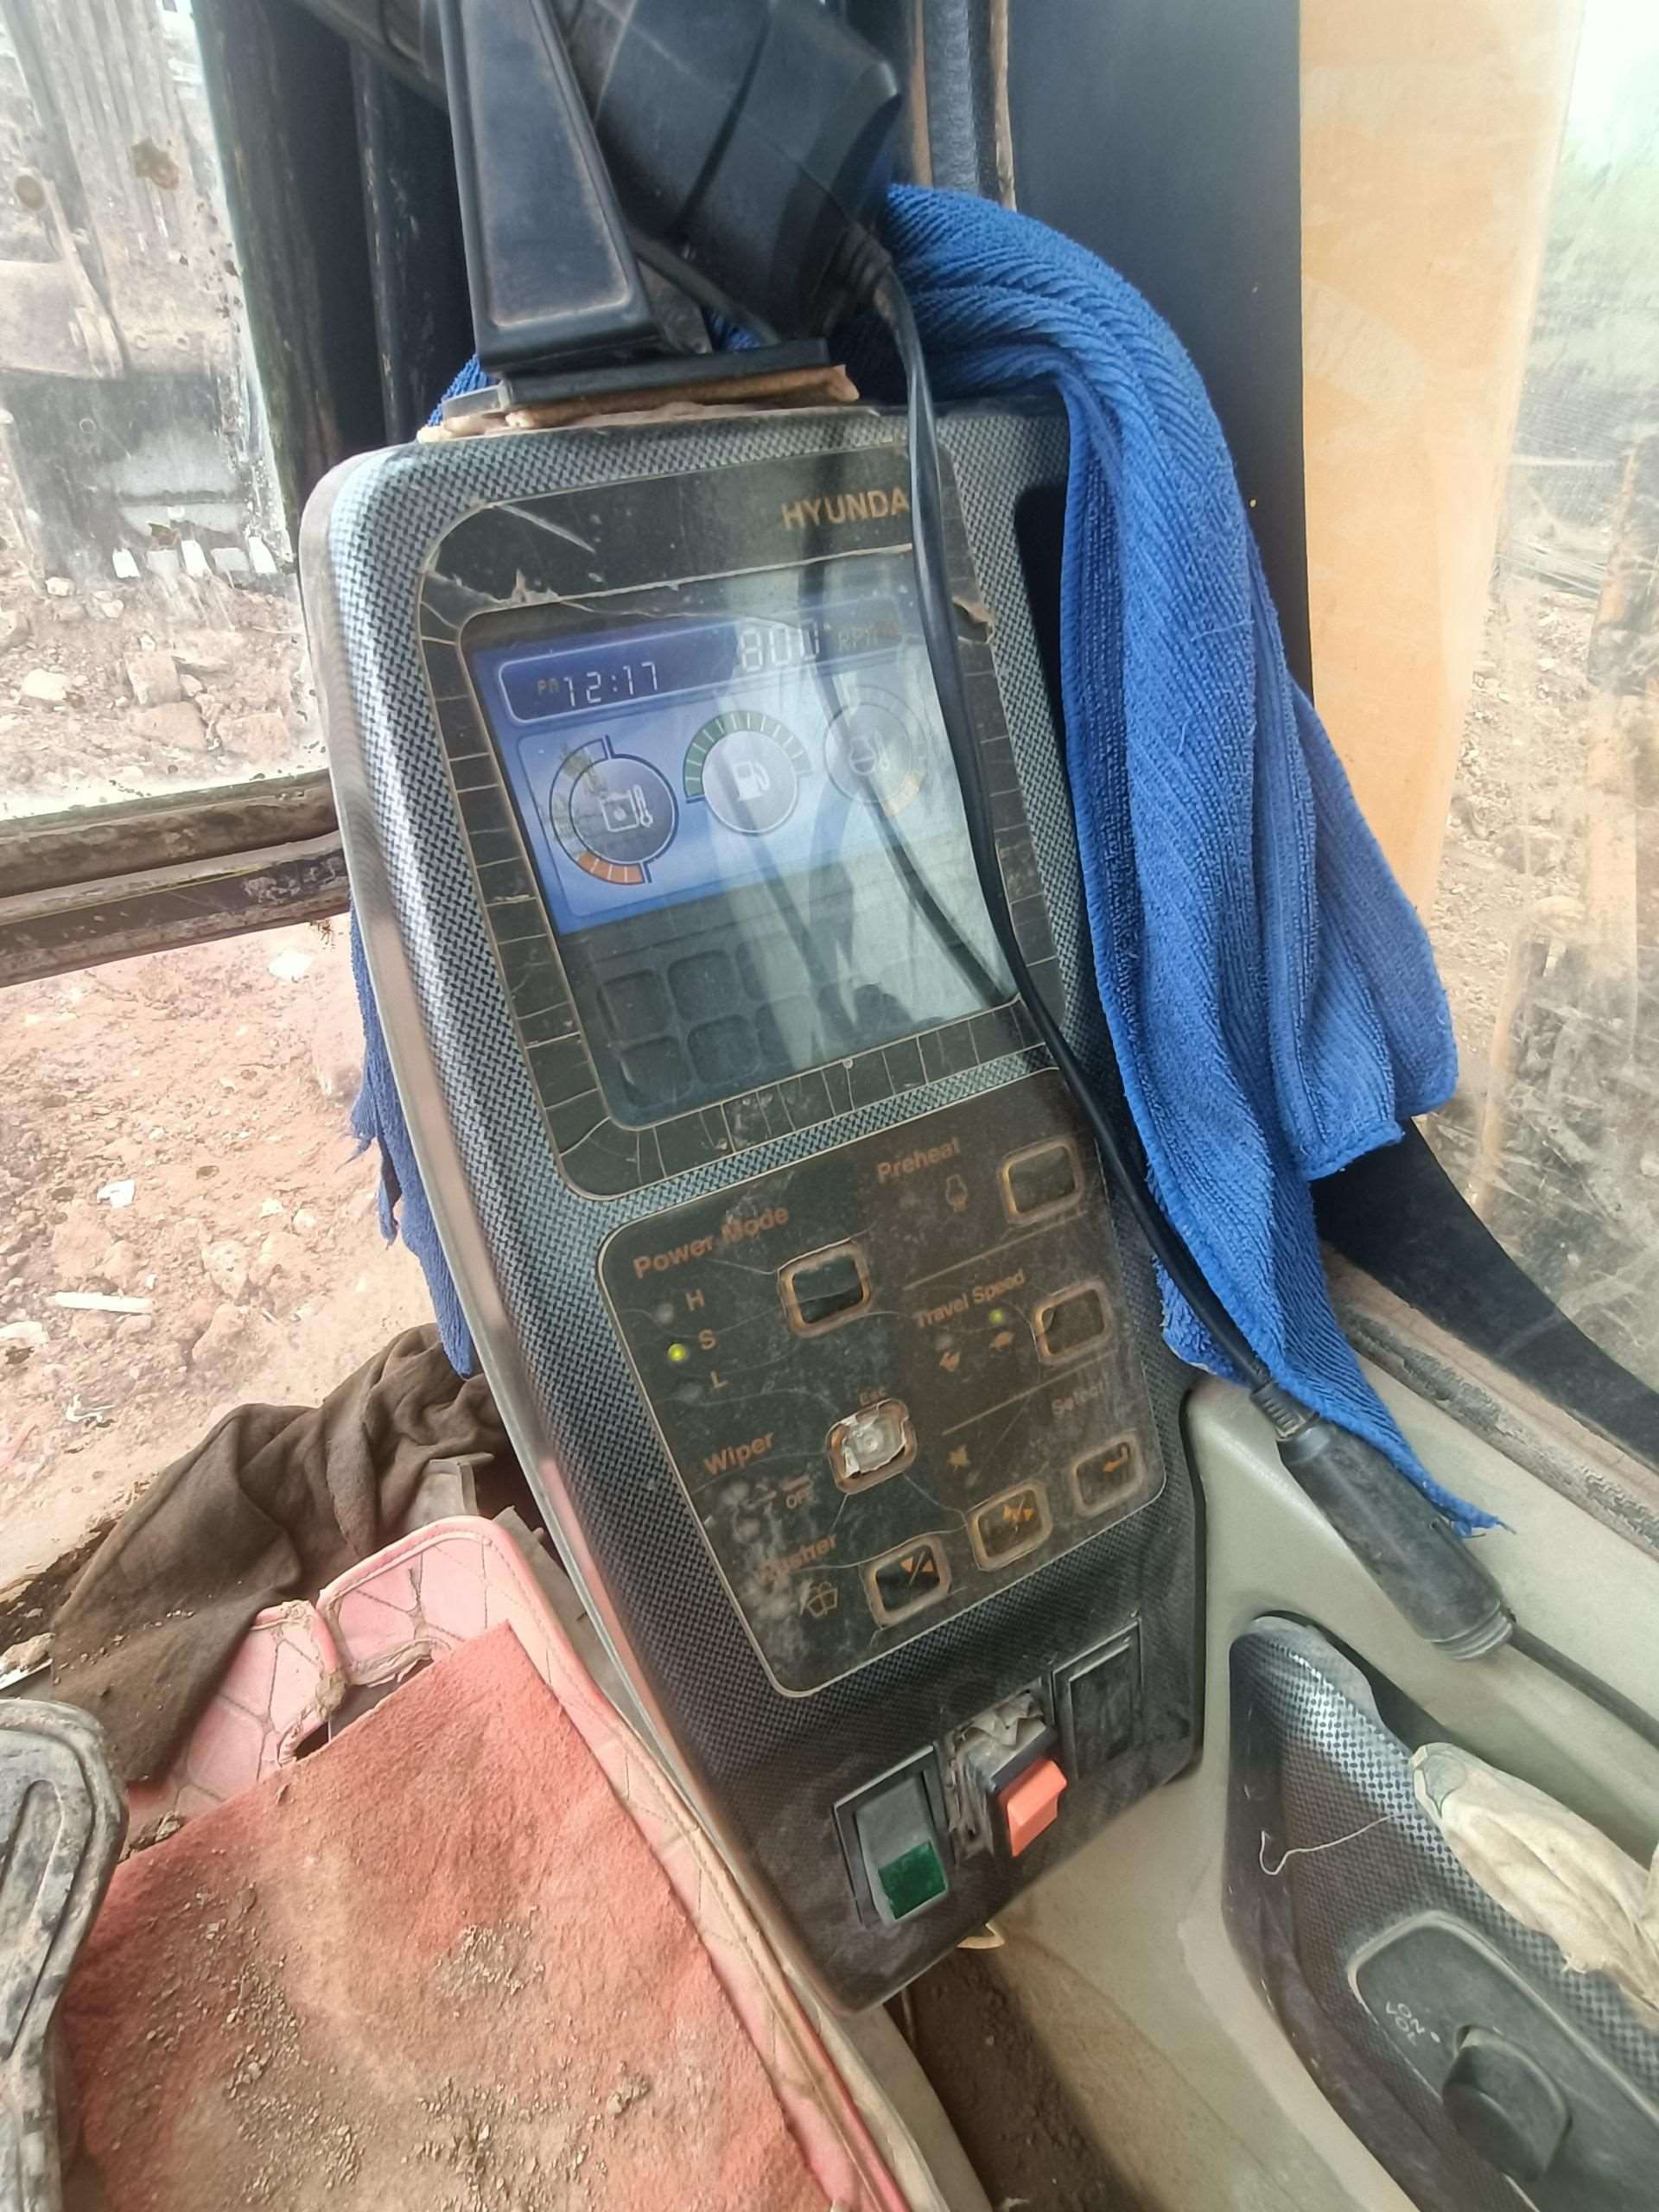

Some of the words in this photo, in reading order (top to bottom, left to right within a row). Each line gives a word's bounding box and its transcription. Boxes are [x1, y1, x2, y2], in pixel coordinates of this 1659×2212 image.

[781, 485, 910, 530] HYUNDA
[563, 661, 658, 707] 12:17
[877, 1136, 961, 1185] Preheat
[633, 1235, 714, 1279] Power
[720, 1207, 789, 1245] Mode
[685, 1288, 705, 1312] H
[914, 1293, 969, 1328] Travel
[972, 1268, 1026, 1305] Speed
[697, 1328, 717, 1351] S
[709, 1370, 729, 1389] L
[704, 1432, 775, 1476] Wiper
